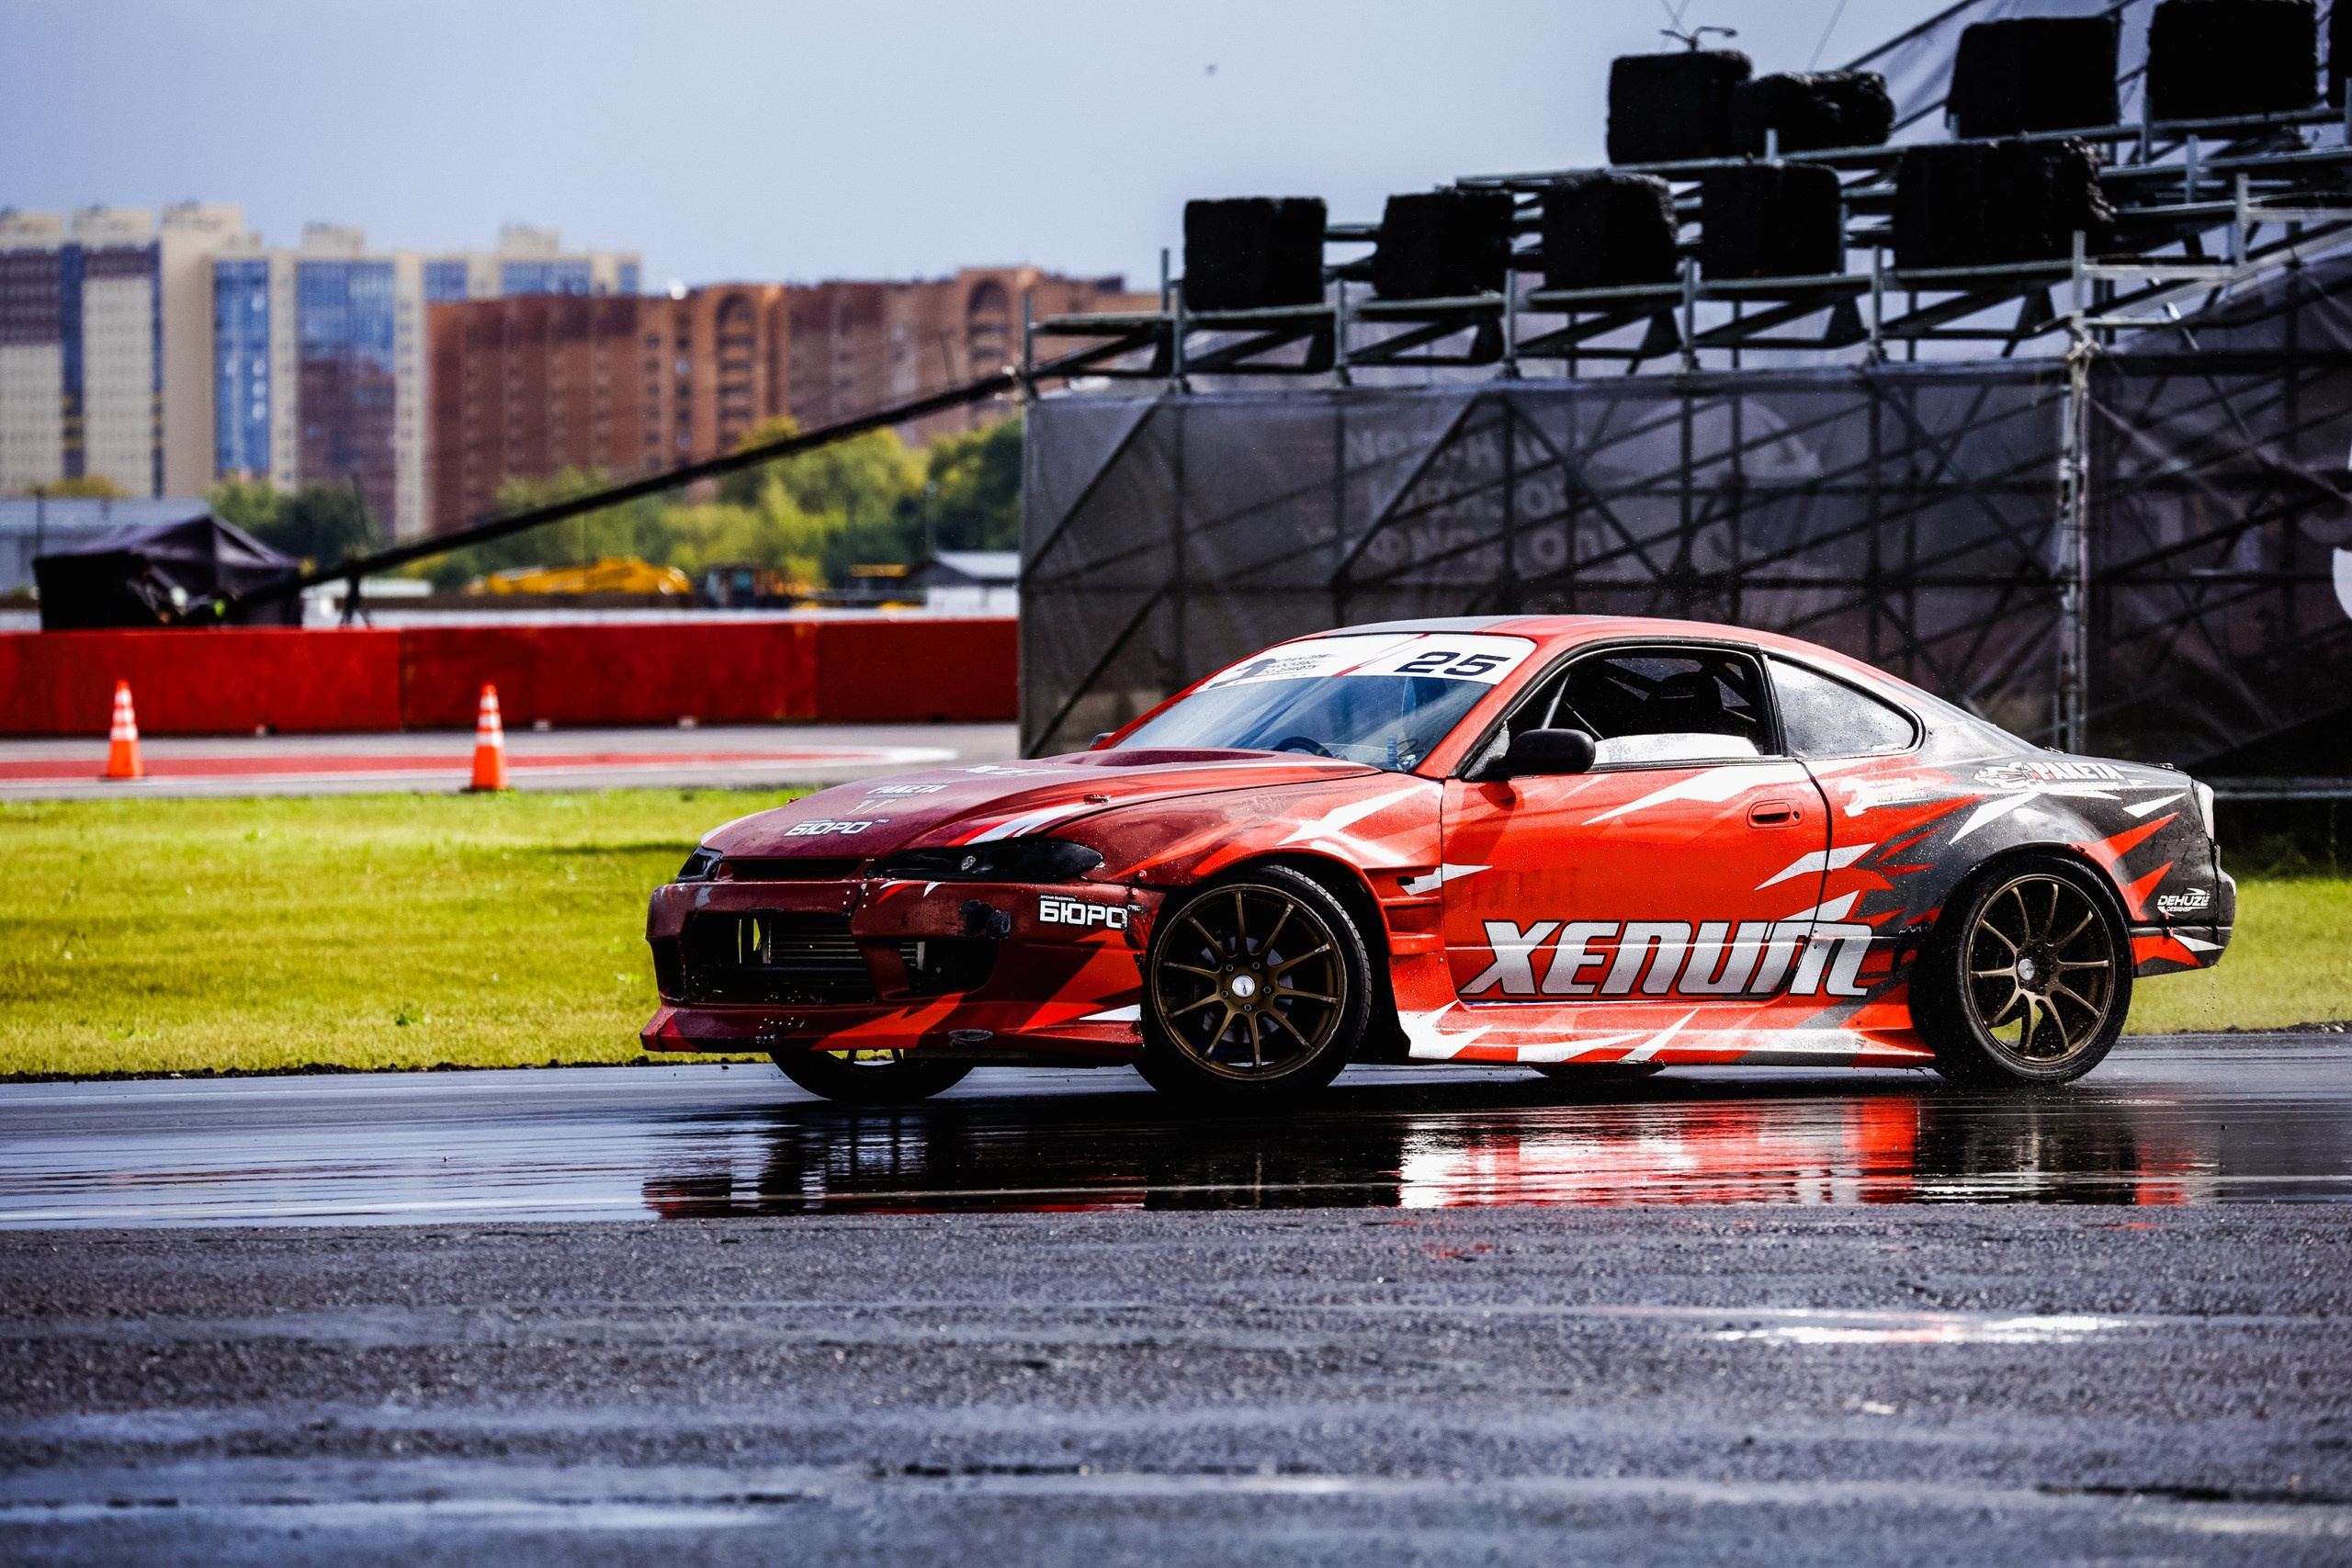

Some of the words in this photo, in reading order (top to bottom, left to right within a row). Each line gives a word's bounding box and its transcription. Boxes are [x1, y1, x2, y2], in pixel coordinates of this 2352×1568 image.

[1392, 651, 1511, 676] 25
[783, 821, 873, 837] БЮРО
[1039, 900, 1128, 929] БЮРО
[1457, 919, 1873, 997] XENUM
